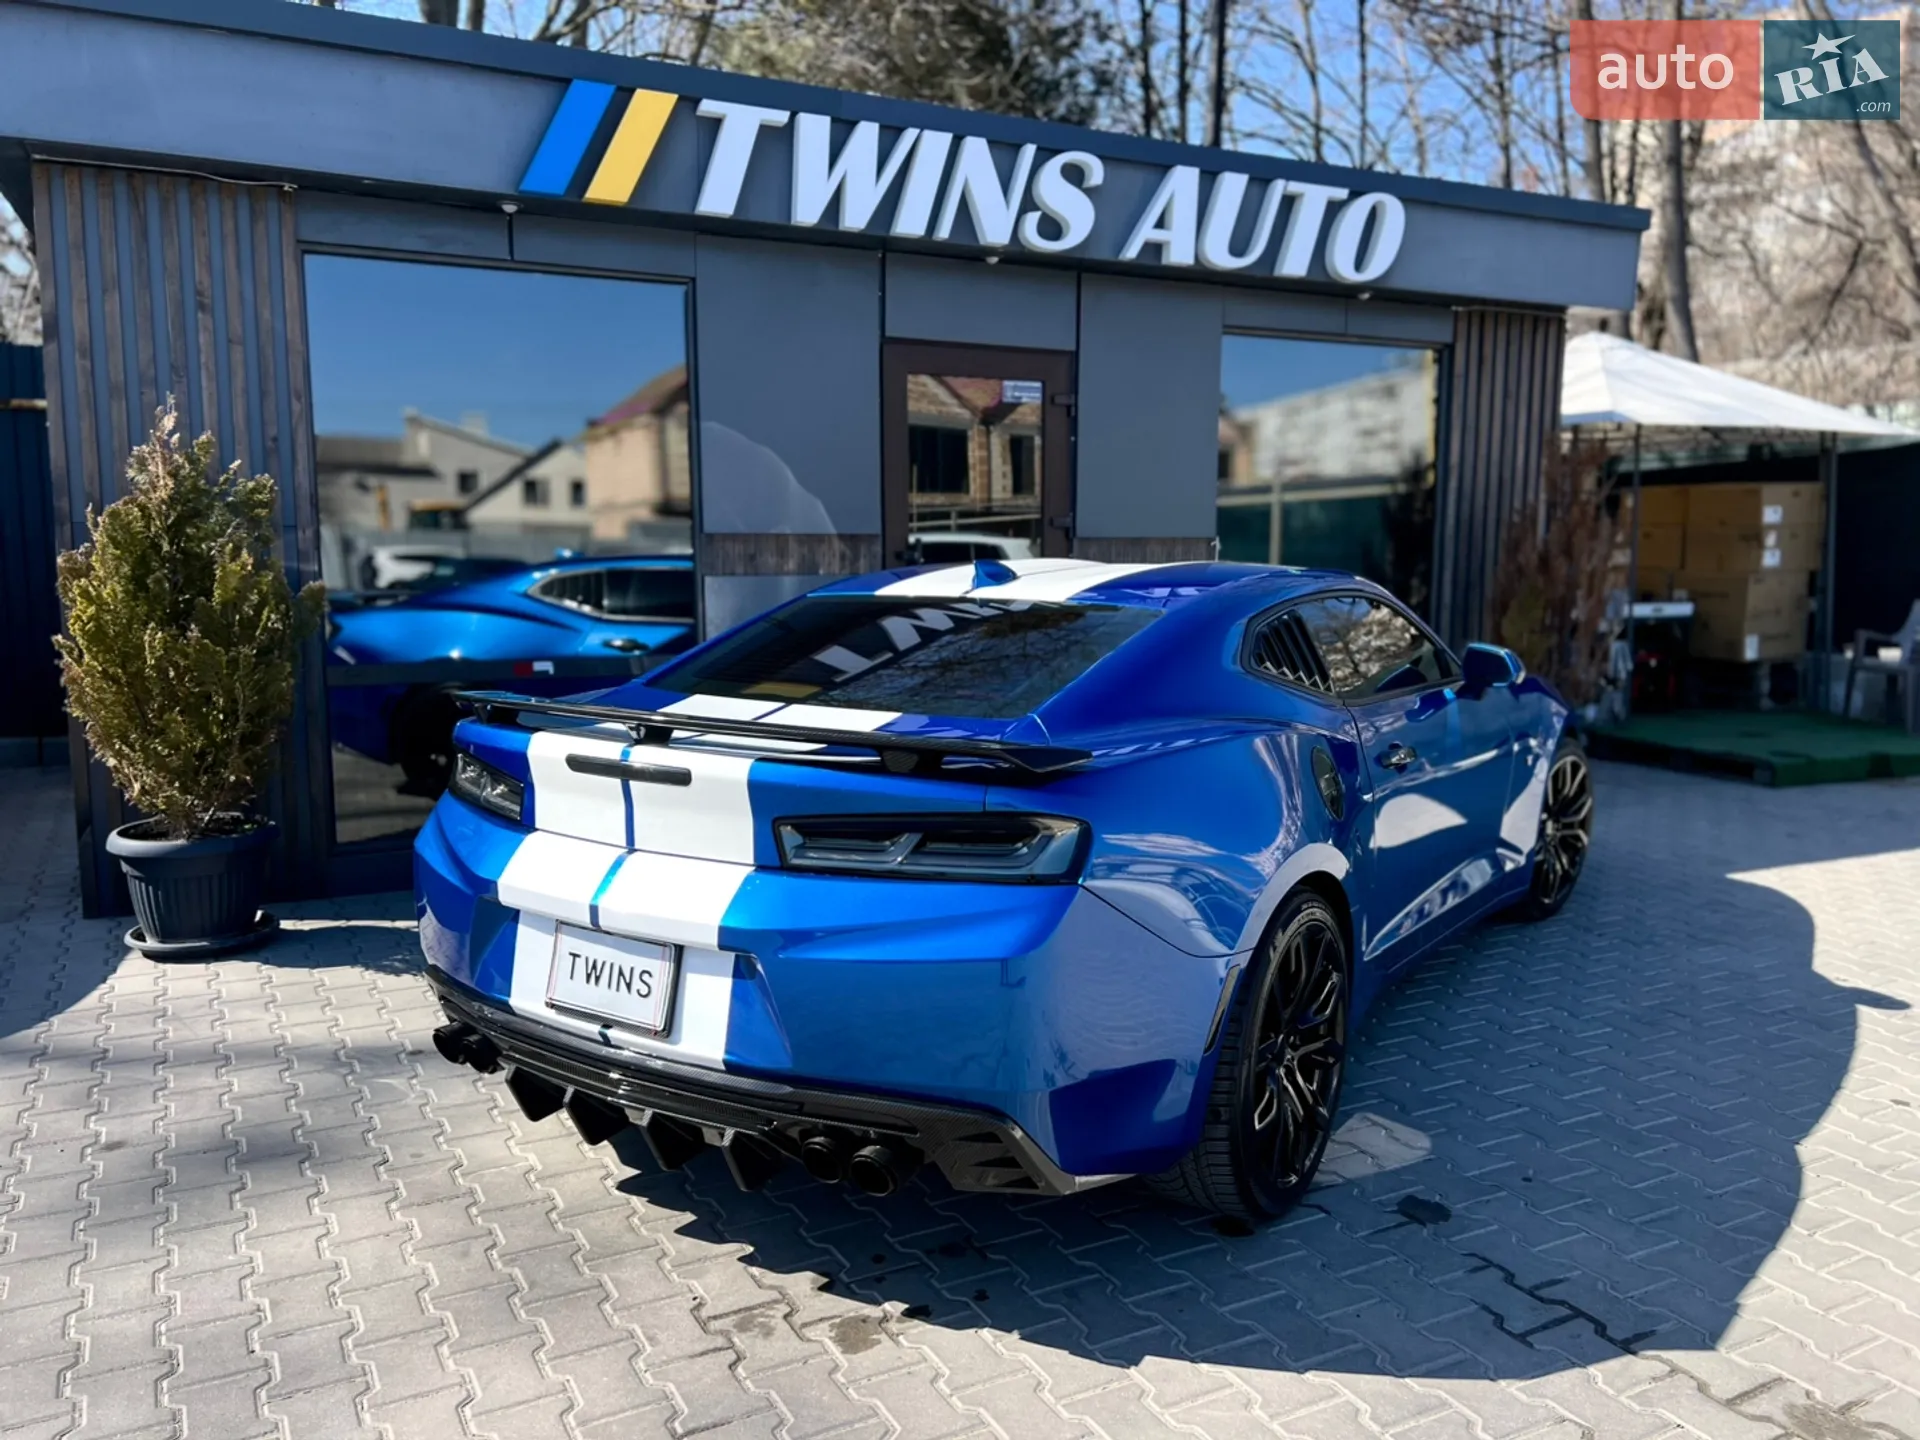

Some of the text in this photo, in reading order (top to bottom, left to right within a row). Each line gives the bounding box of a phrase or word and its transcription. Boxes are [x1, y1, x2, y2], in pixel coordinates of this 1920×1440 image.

[695, 98, 1406, 284] TWINS AUTO
[568, 951, 653, 999] TWINS
